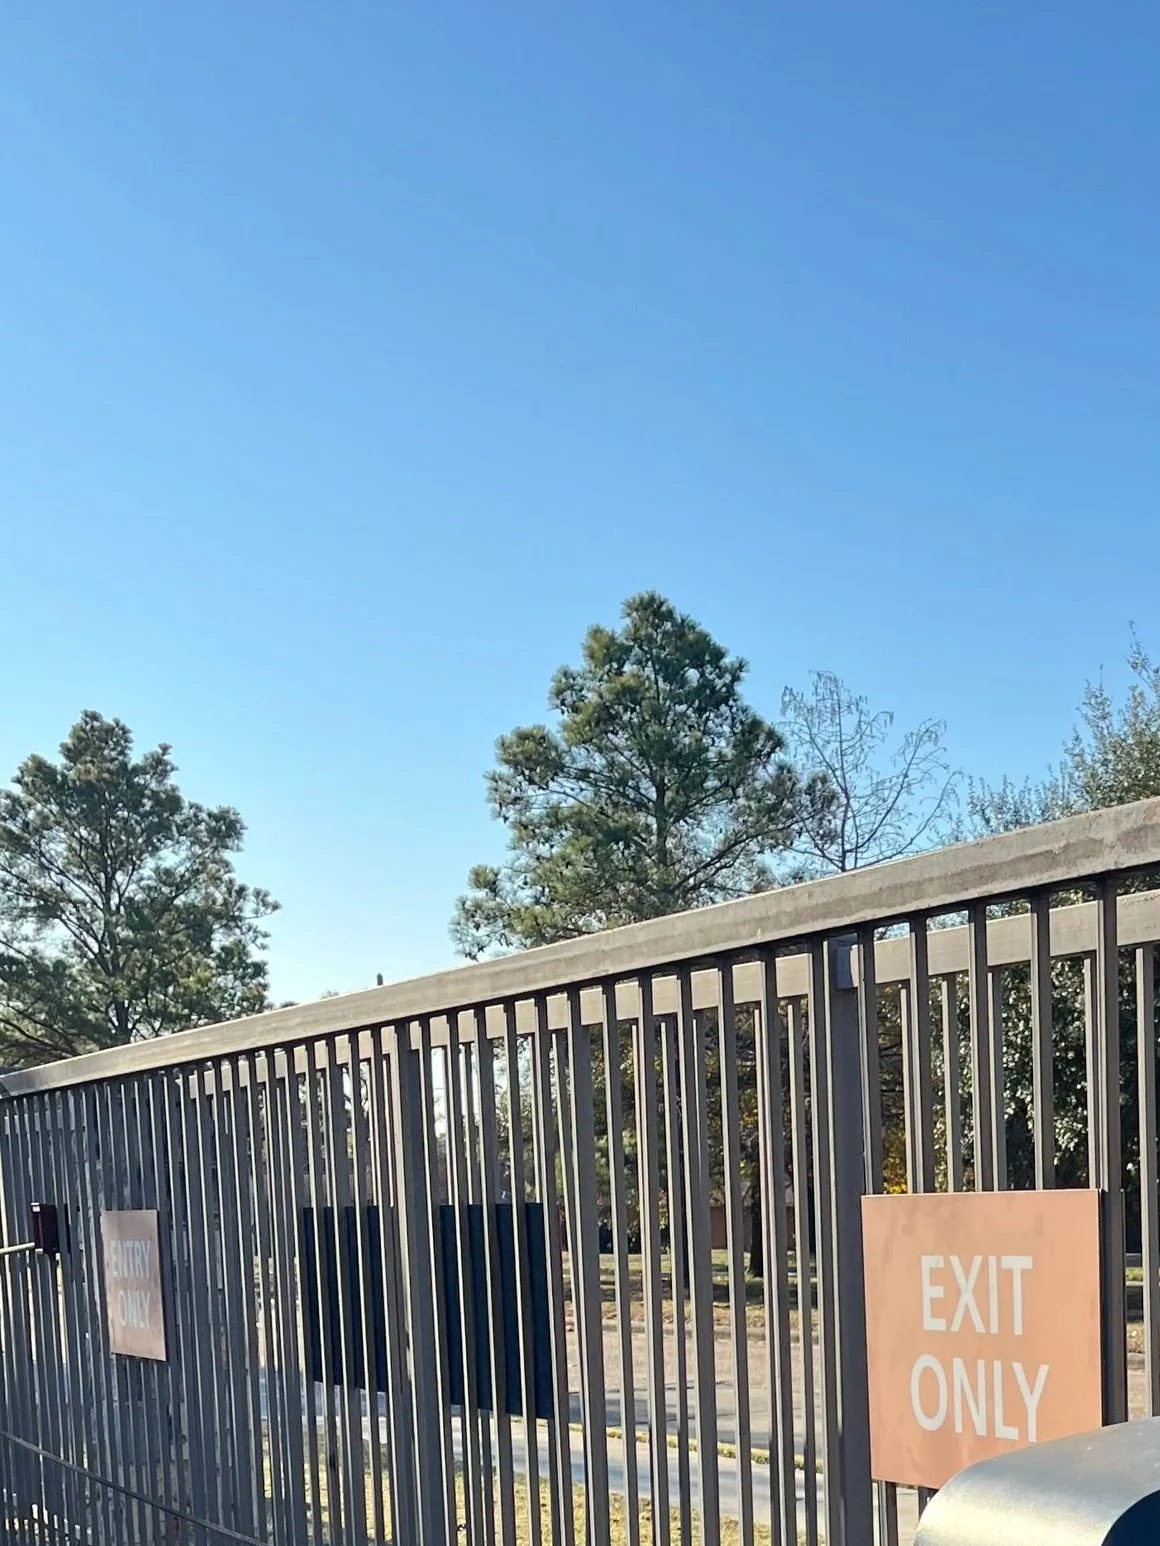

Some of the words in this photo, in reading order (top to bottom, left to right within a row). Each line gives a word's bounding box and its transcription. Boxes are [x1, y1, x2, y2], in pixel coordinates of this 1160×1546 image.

[111, 1240, 151, 1278] ENTRY
[118, 1289, 150, 1328] ONLY
[920, 1255, 1033, 1336] EXIT
[910, 1353, 1050, 1443] ONLY
